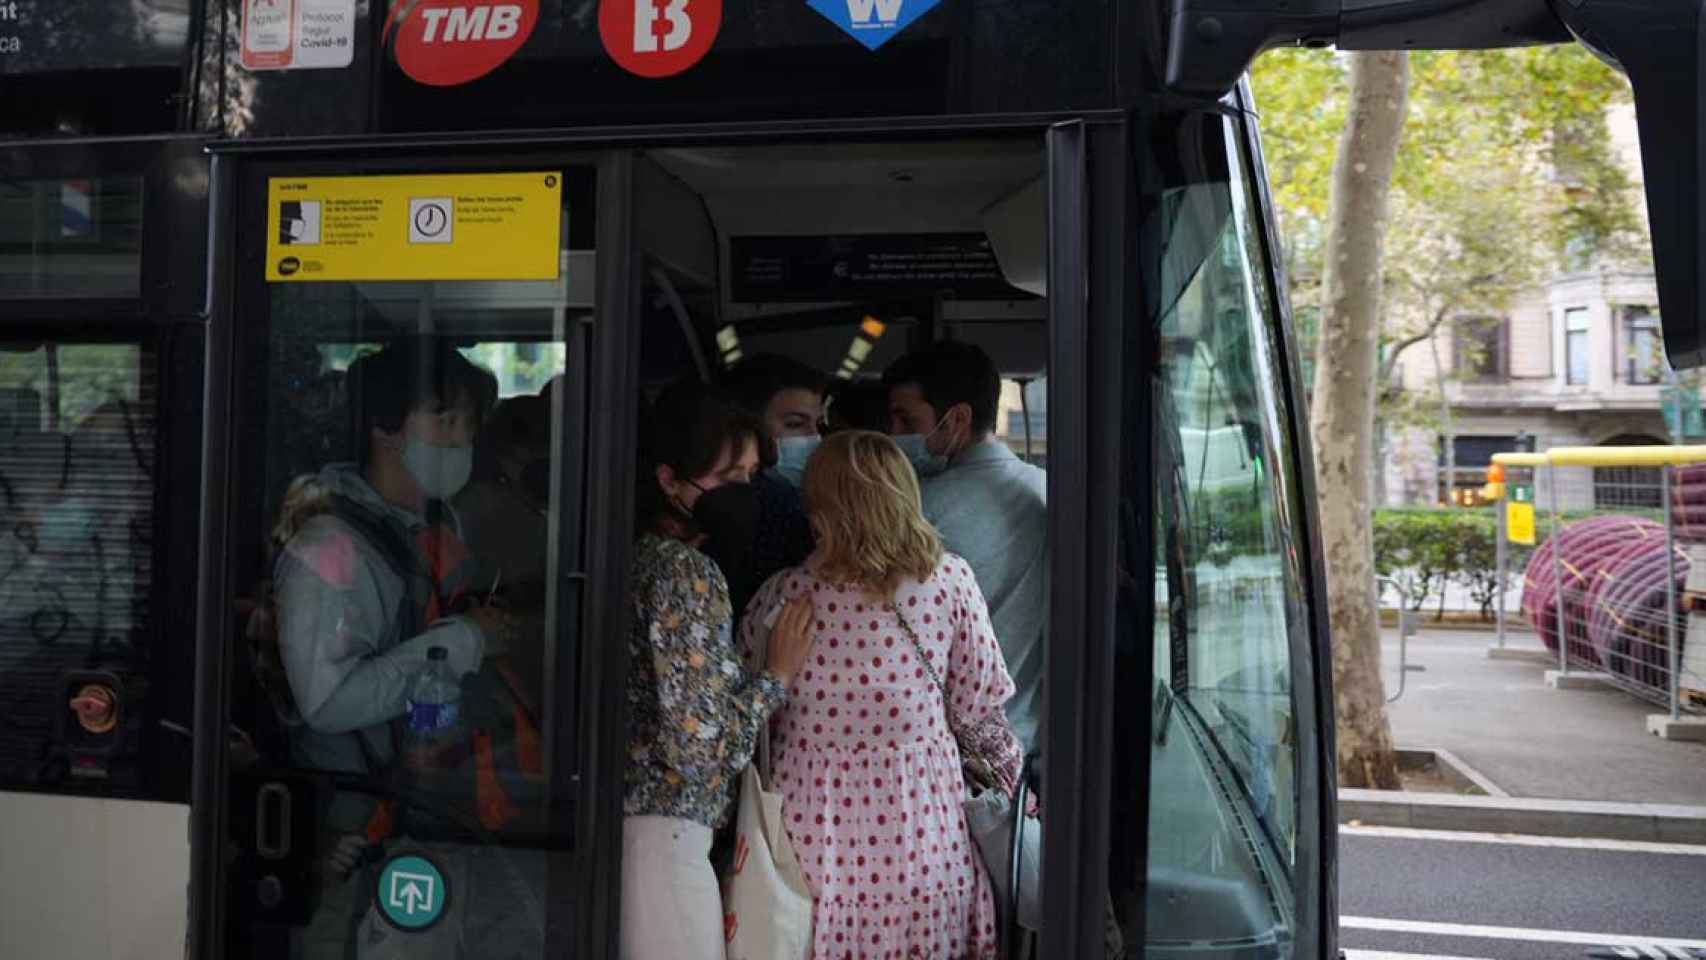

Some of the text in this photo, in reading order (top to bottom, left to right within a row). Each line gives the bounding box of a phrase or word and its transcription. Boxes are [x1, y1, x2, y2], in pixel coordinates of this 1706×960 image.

[300, 37, 349, 49] Covid-19
[422, 4, 522, 43] TMB
[633, 0, 692, 53] B
